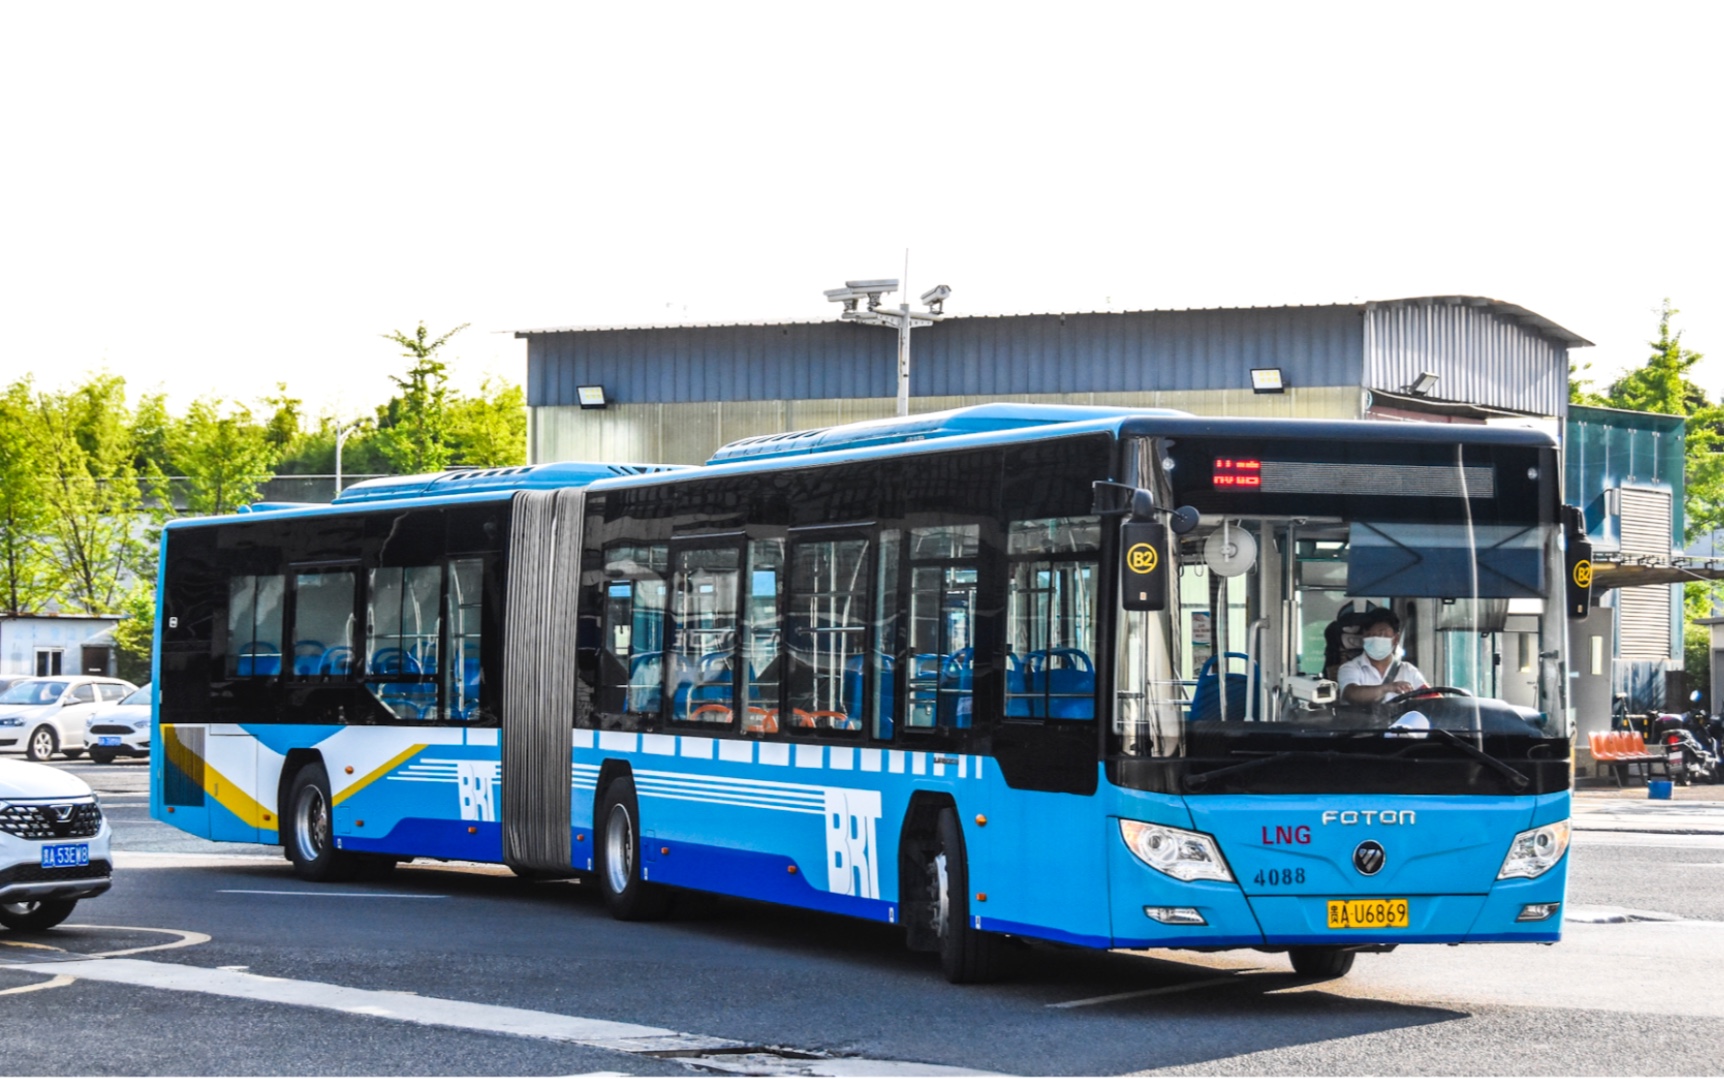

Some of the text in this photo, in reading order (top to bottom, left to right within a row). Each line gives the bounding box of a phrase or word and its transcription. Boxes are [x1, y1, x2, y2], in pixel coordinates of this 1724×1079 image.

[1133, 551, 1154, 567] B2
[458, 760, 497, 822] BRT
[1321, 810, 1416, 826] FOTON
[824, 786, 882, 900] BRT
[1262, 826, 1311, 844] LNG
[1254, 868, 1306, 886] 4088
